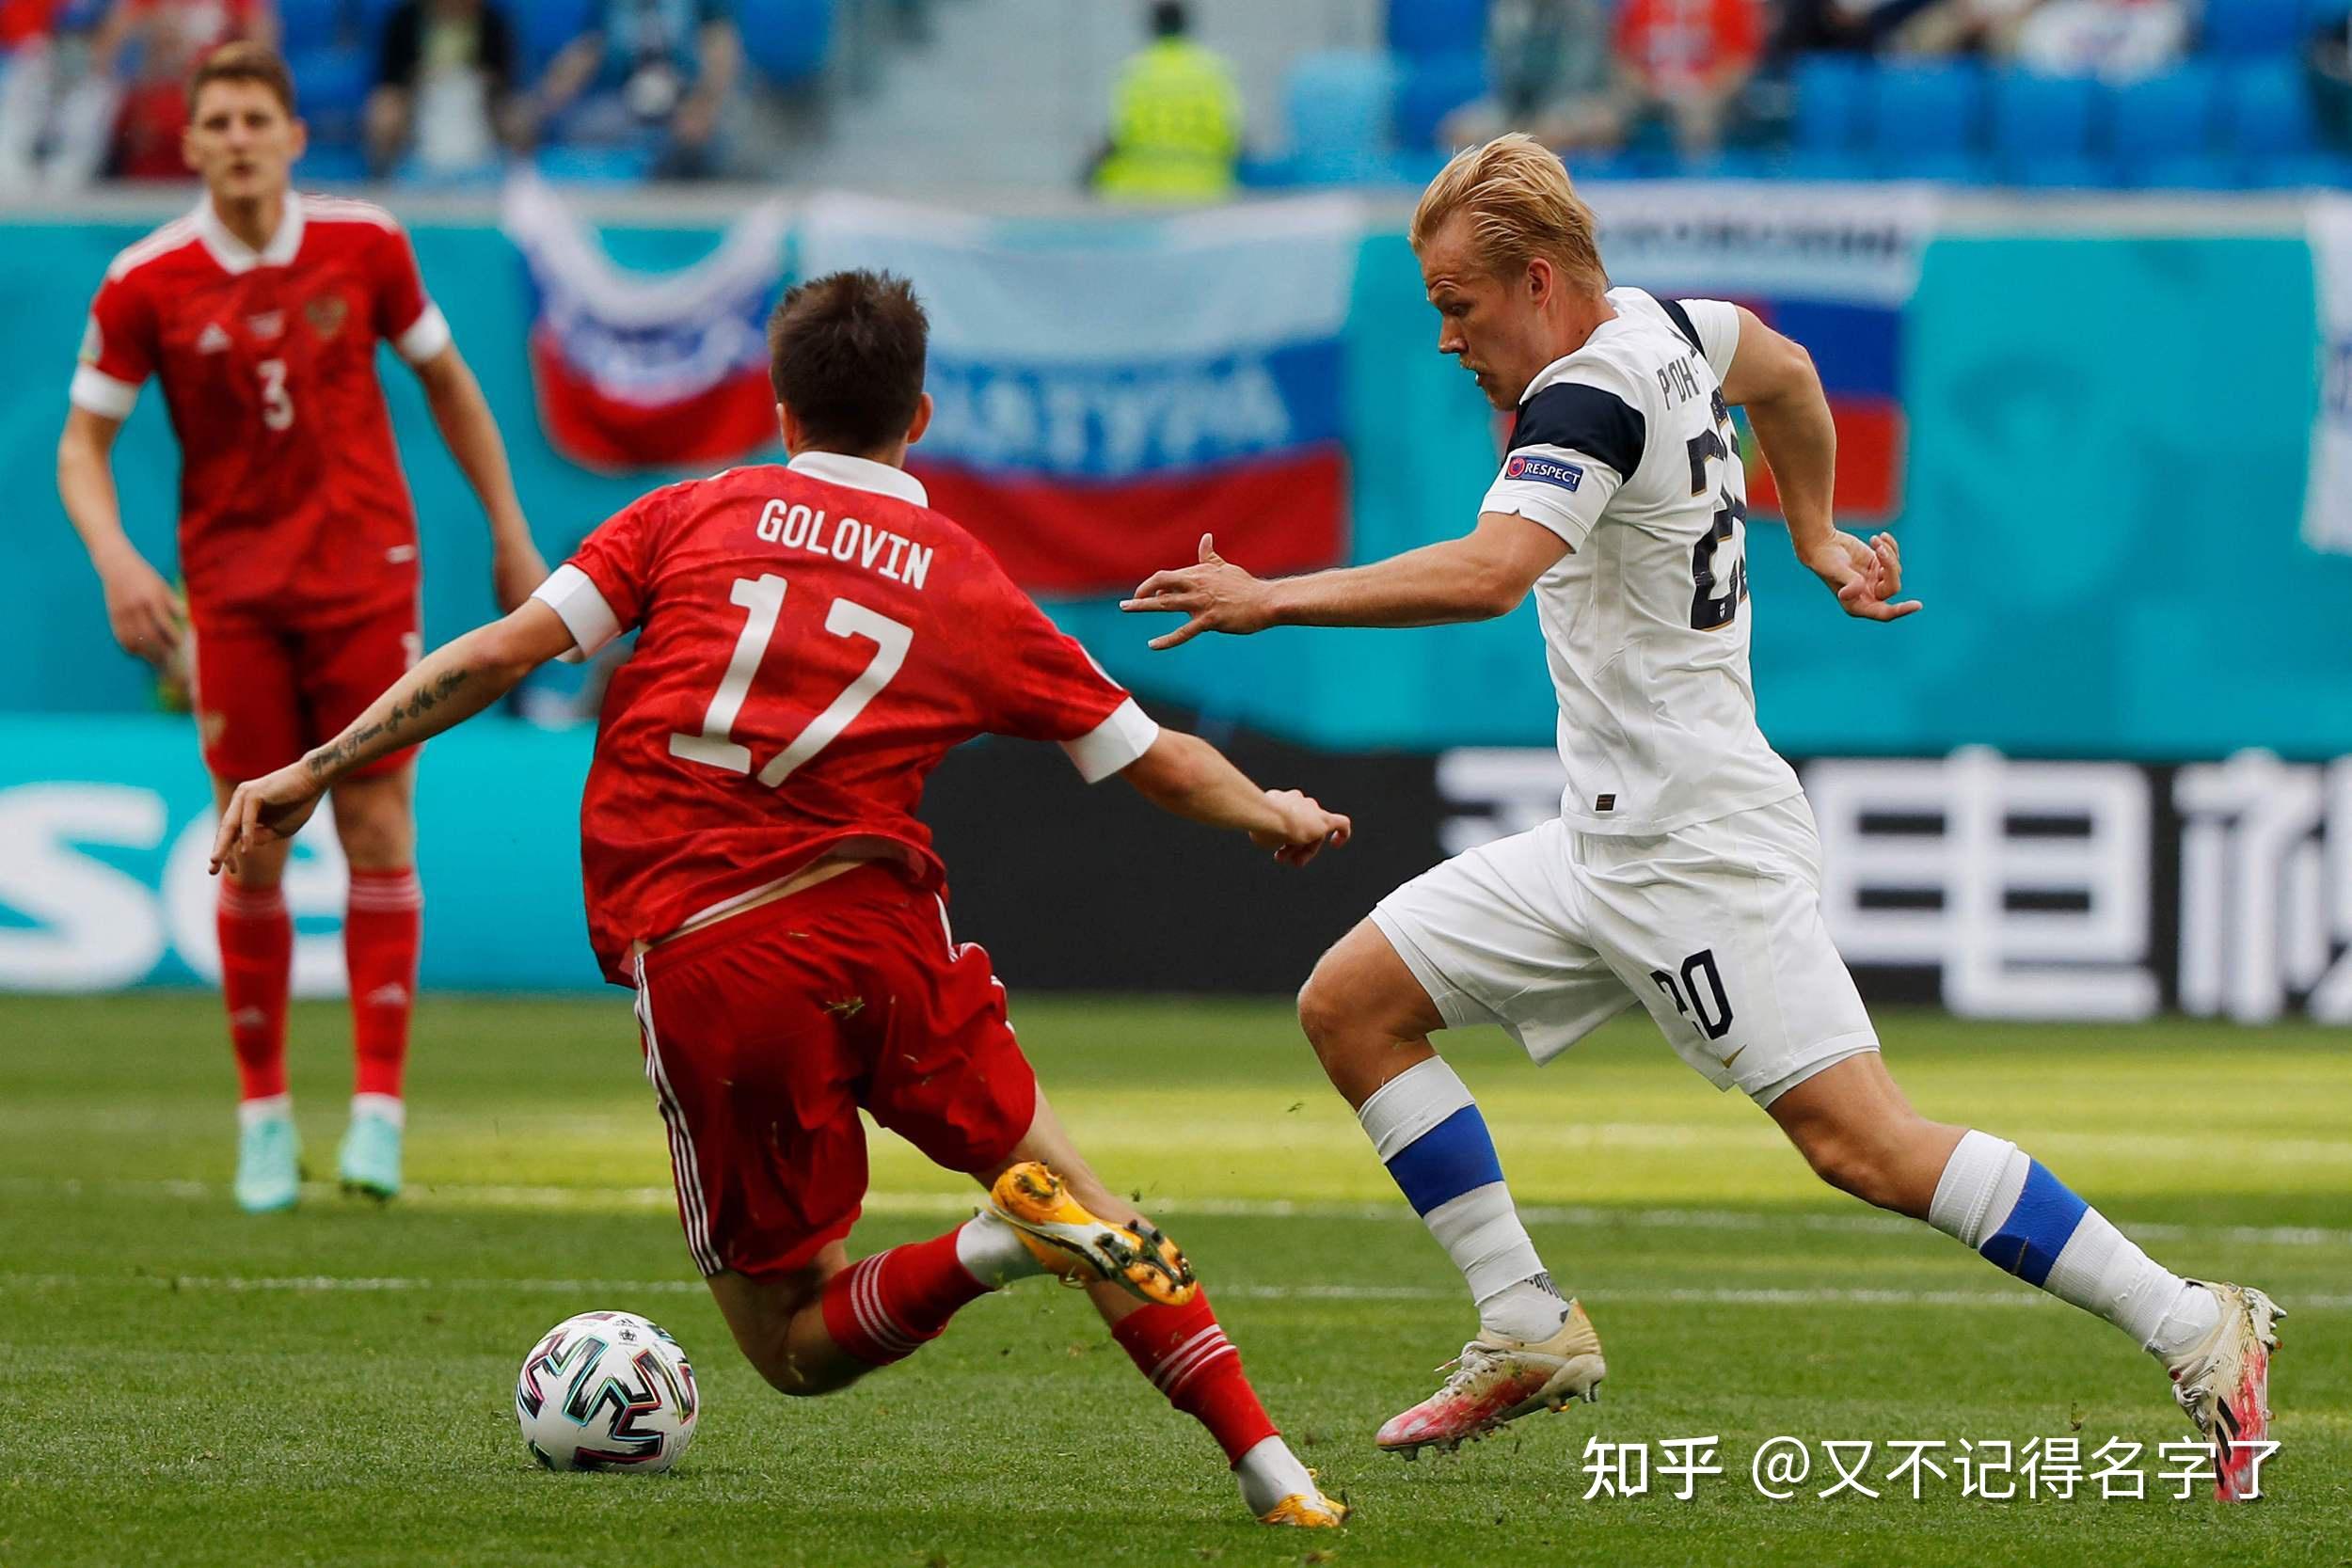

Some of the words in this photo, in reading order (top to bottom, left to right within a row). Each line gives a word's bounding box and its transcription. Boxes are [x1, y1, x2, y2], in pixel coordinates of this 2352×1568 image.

[257, 358, 294, 431] 3
[1524, 462, 1581, 485] RESPECT
[756, 499, 933, 591] GOLOVIN
[669, 573, 914, 788] 17
